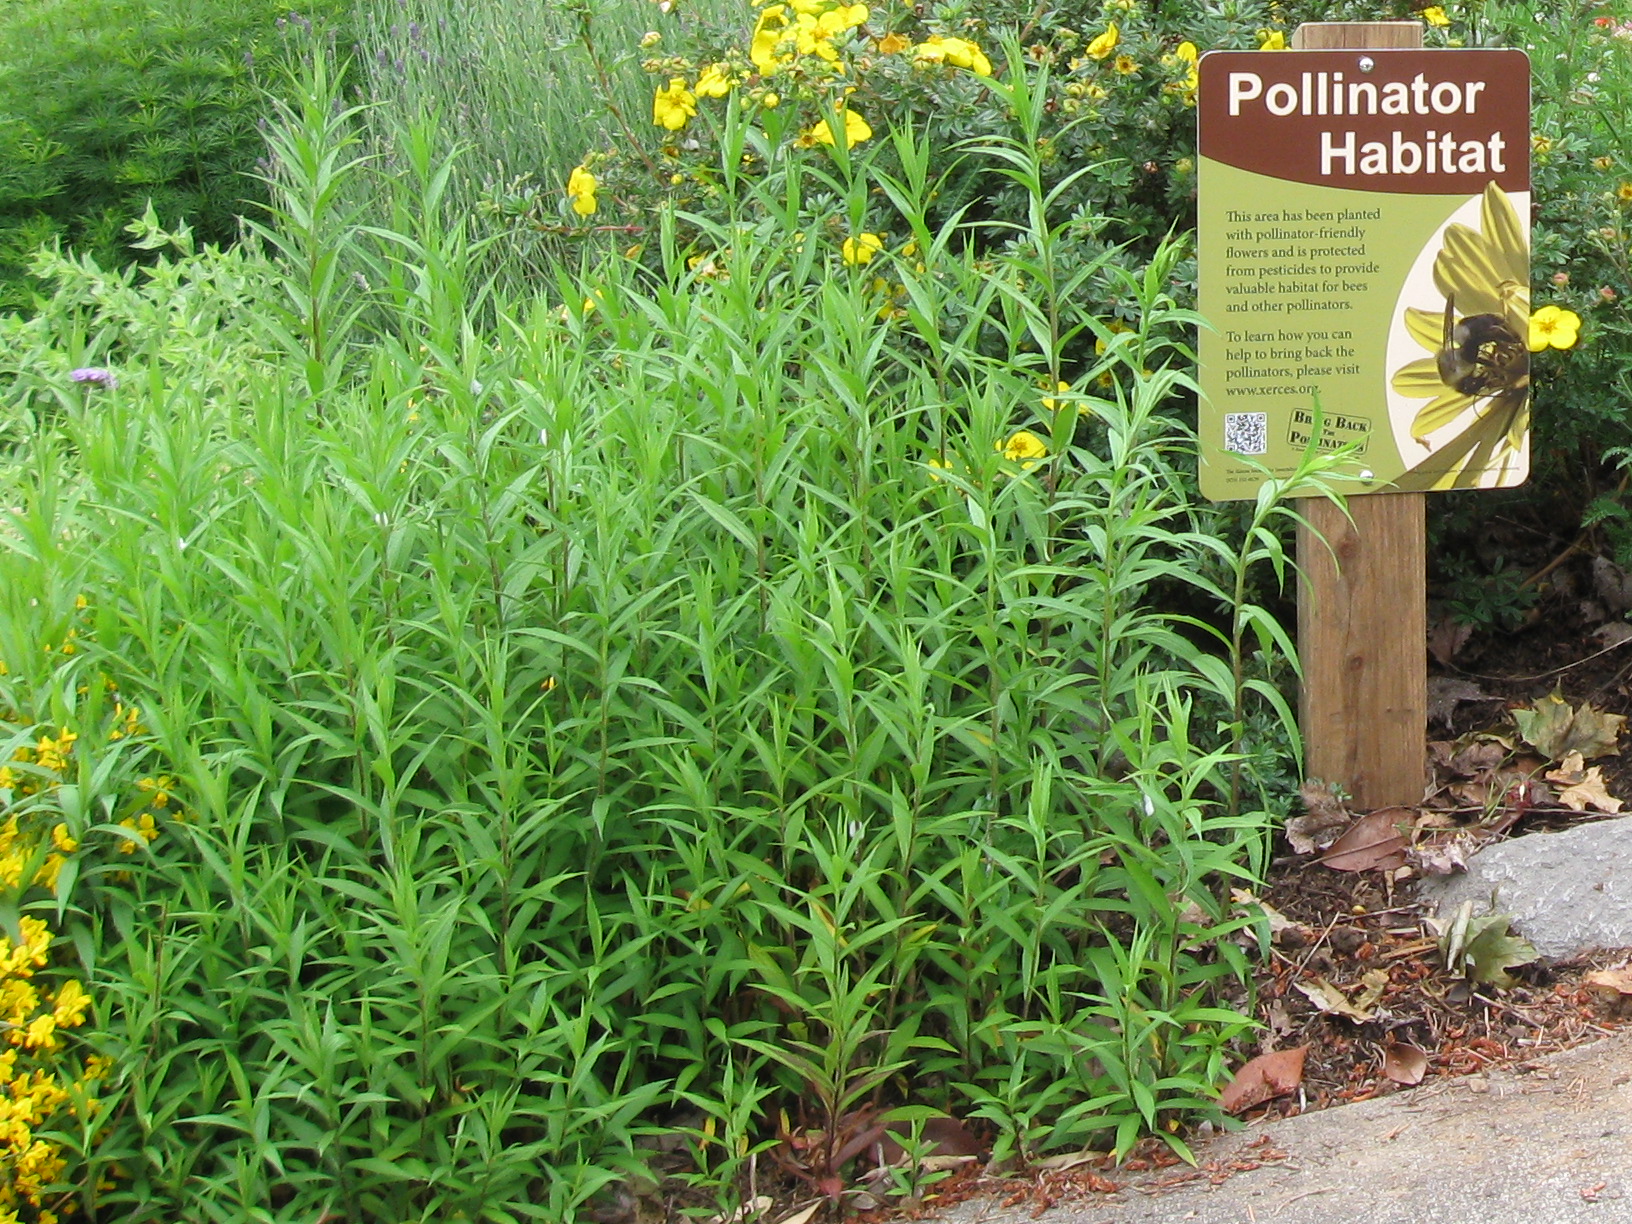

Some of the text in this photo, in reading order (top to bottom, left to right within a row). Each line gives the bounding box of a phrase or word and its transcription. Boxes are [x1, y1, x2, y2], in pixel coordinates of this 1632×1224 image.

[1227, 72, 1486, 116] Pollinator
[1320, 131, 1506, 175] Habitat
[1227, 208, 1380, 223] This area has been planted
[1227, 227, 1365, 243] with pollinator-friendly
[1226, 245, 1365, 259] flowers and is protected
[1226, 262, 1379, 278] from pesticides to provide
[1226, 280, 1367, 294] valuable habitat for bees
[1226, 299, 1353, 313] and other pollinators.
[1227, 330, 1351, 343] To learn how you can
[1226, 346, 1355, 362] help to bring back the
[1226, 364, 1359, 381] pollinators, please visit
